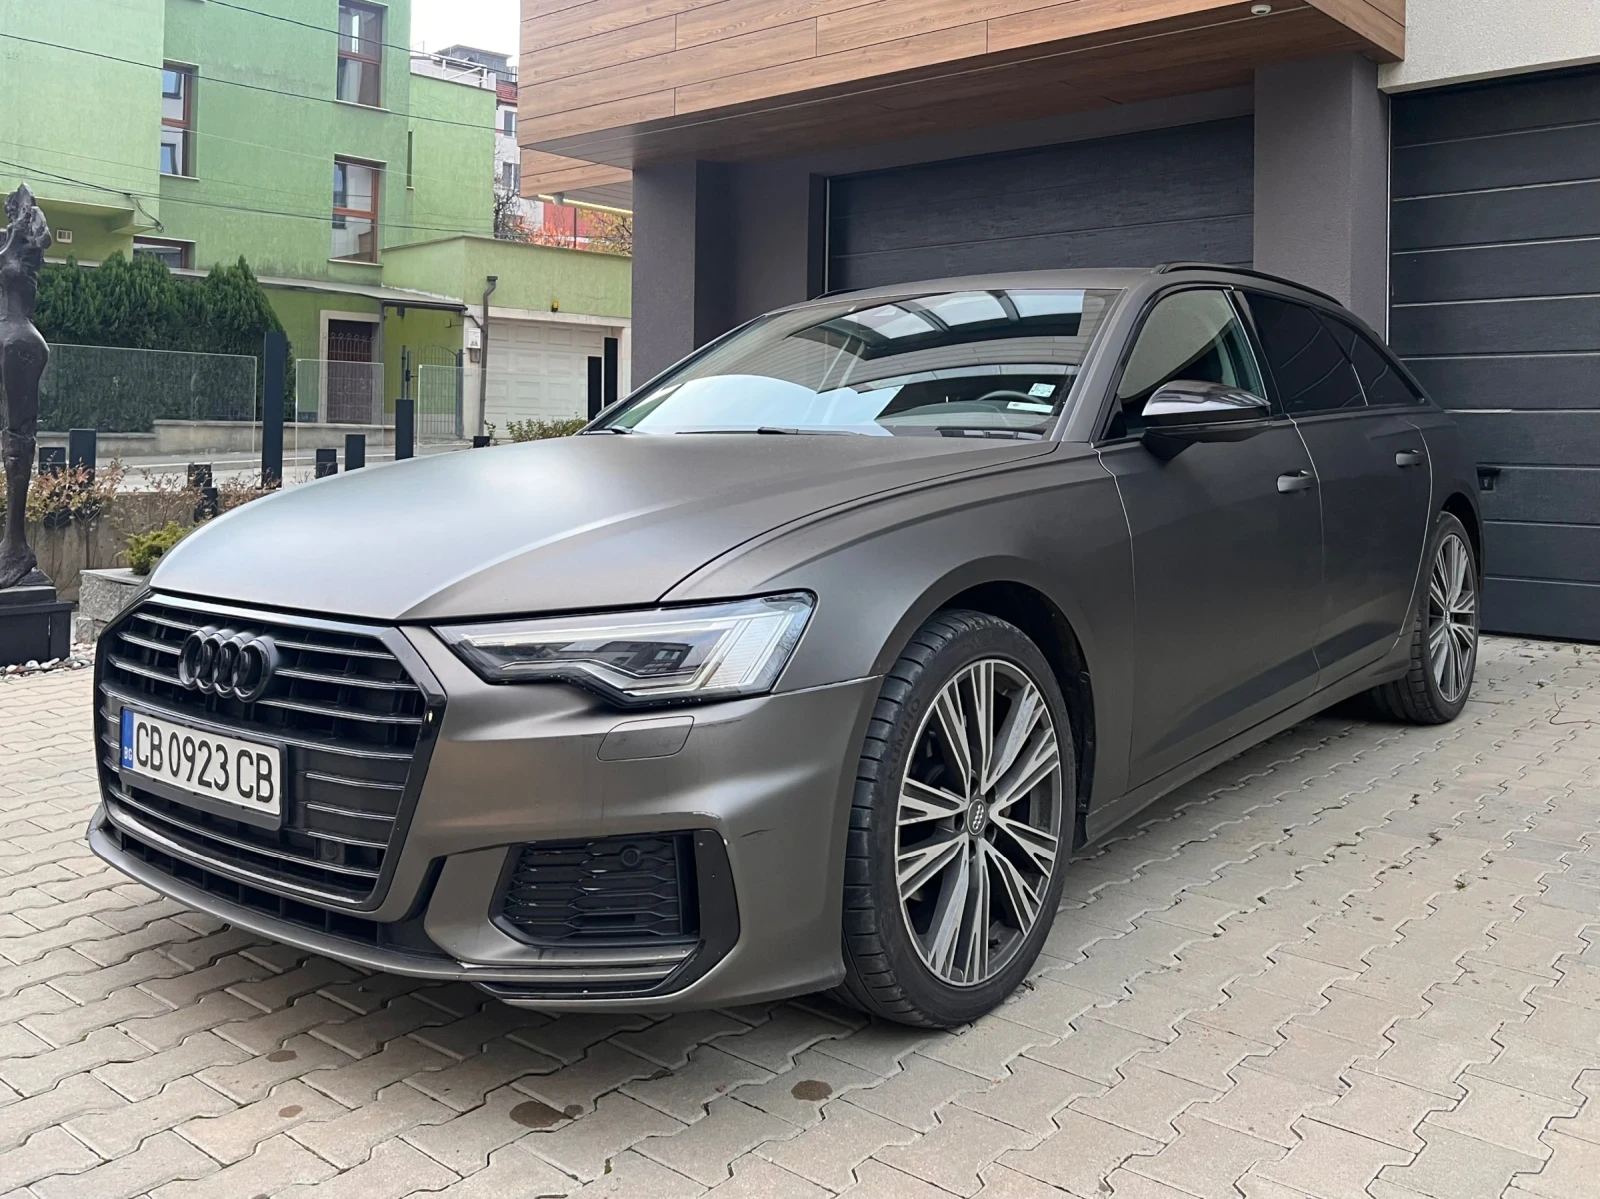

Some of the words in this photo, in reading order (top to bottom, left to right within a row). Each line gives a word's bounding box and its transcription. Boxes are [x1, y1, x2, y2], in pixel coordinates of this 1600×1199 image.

[124, 746, 133, 760] BG
[136, 721, 164, 772] CB
[169, 731, 230, 792] 0923
[236, 749, 274, 803] CB
[887, 698, 921, 781] KUMHO
